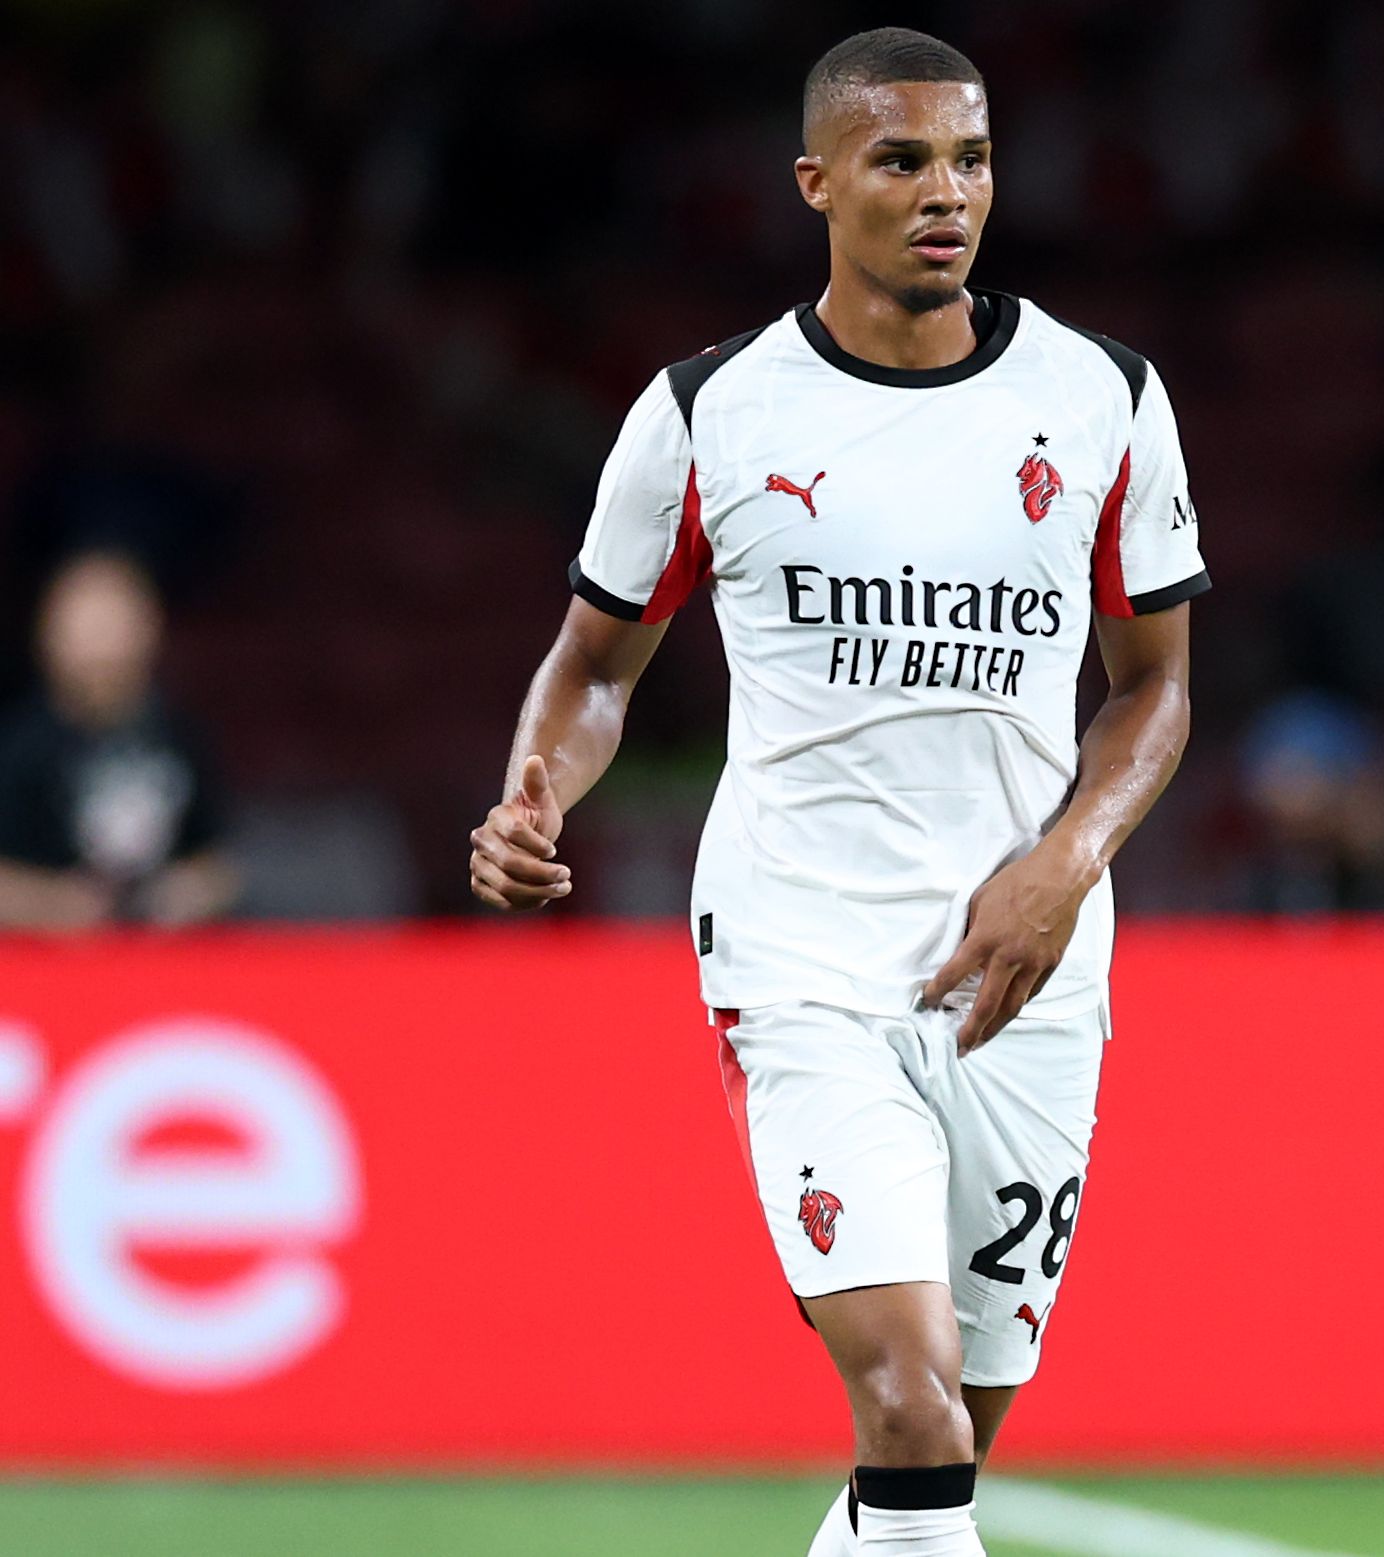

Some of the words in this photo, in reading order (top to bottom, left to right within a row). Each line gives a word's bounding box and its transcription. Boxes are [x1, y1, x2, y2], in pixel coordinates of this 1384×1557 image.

[780, 565, 1064, 637] Emirates
[829, 637, 890, 686] FLY
[901, 640, 1025, 697] BETTER
[969, 1176, 1081, 1285] 28
